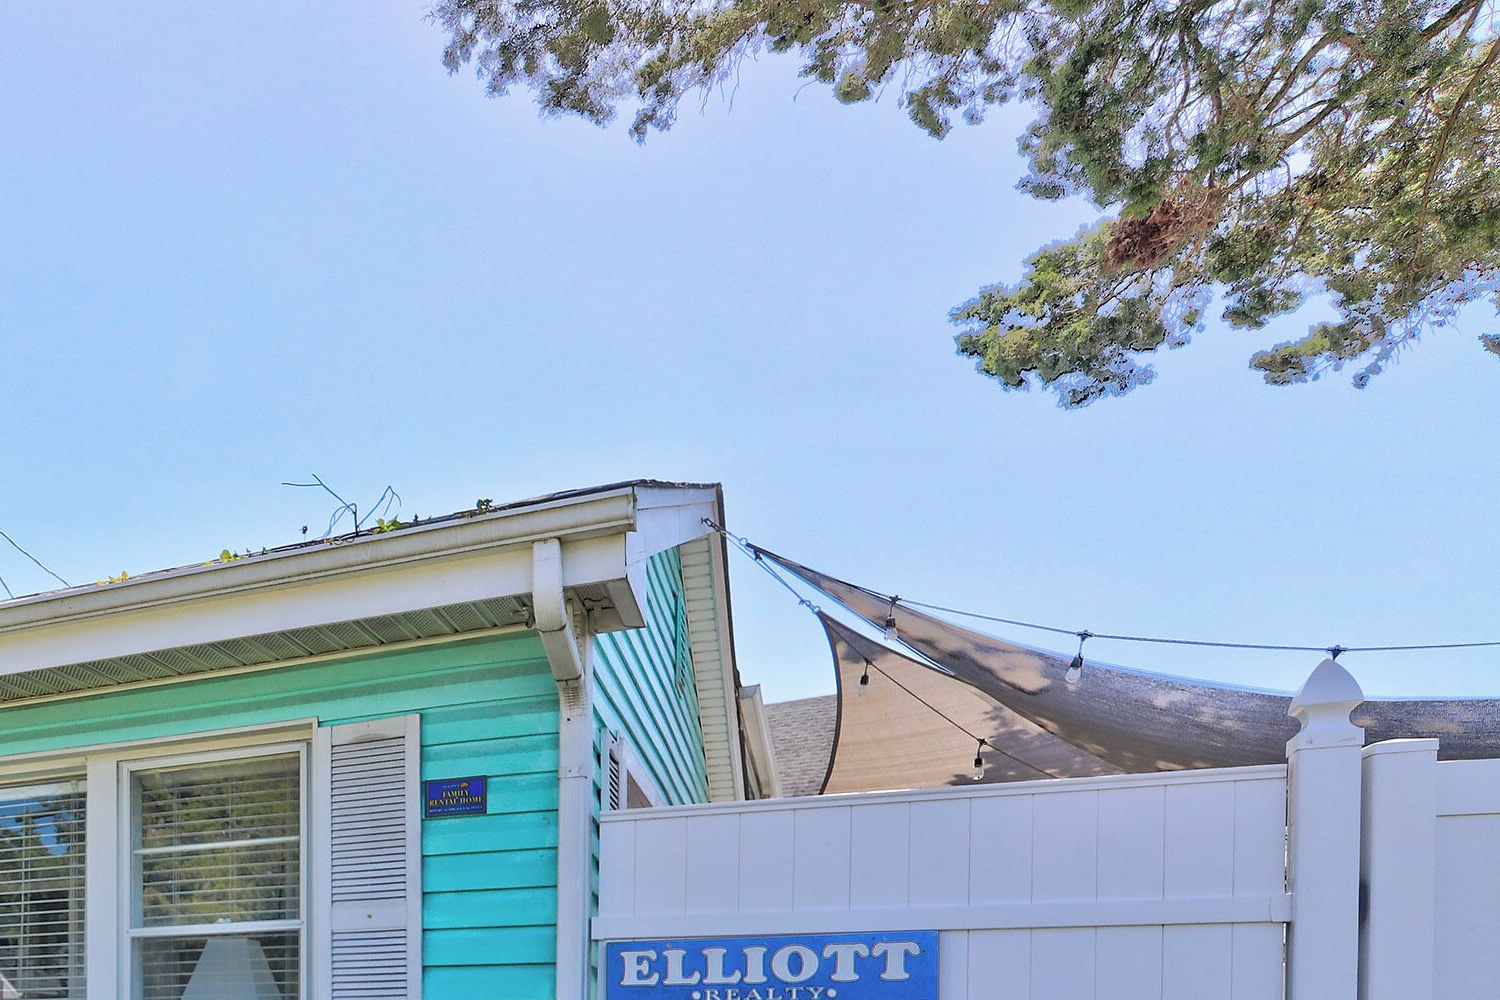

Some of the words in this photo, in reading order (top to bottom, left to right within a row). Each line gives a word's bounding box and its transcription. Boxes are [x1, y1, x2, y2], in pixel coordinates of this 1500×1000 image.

[443, 790, 469, 798] FAMILY
[460, 795, 484, 804] HOME
[619, 941, 921, 986] ELLIOTT
